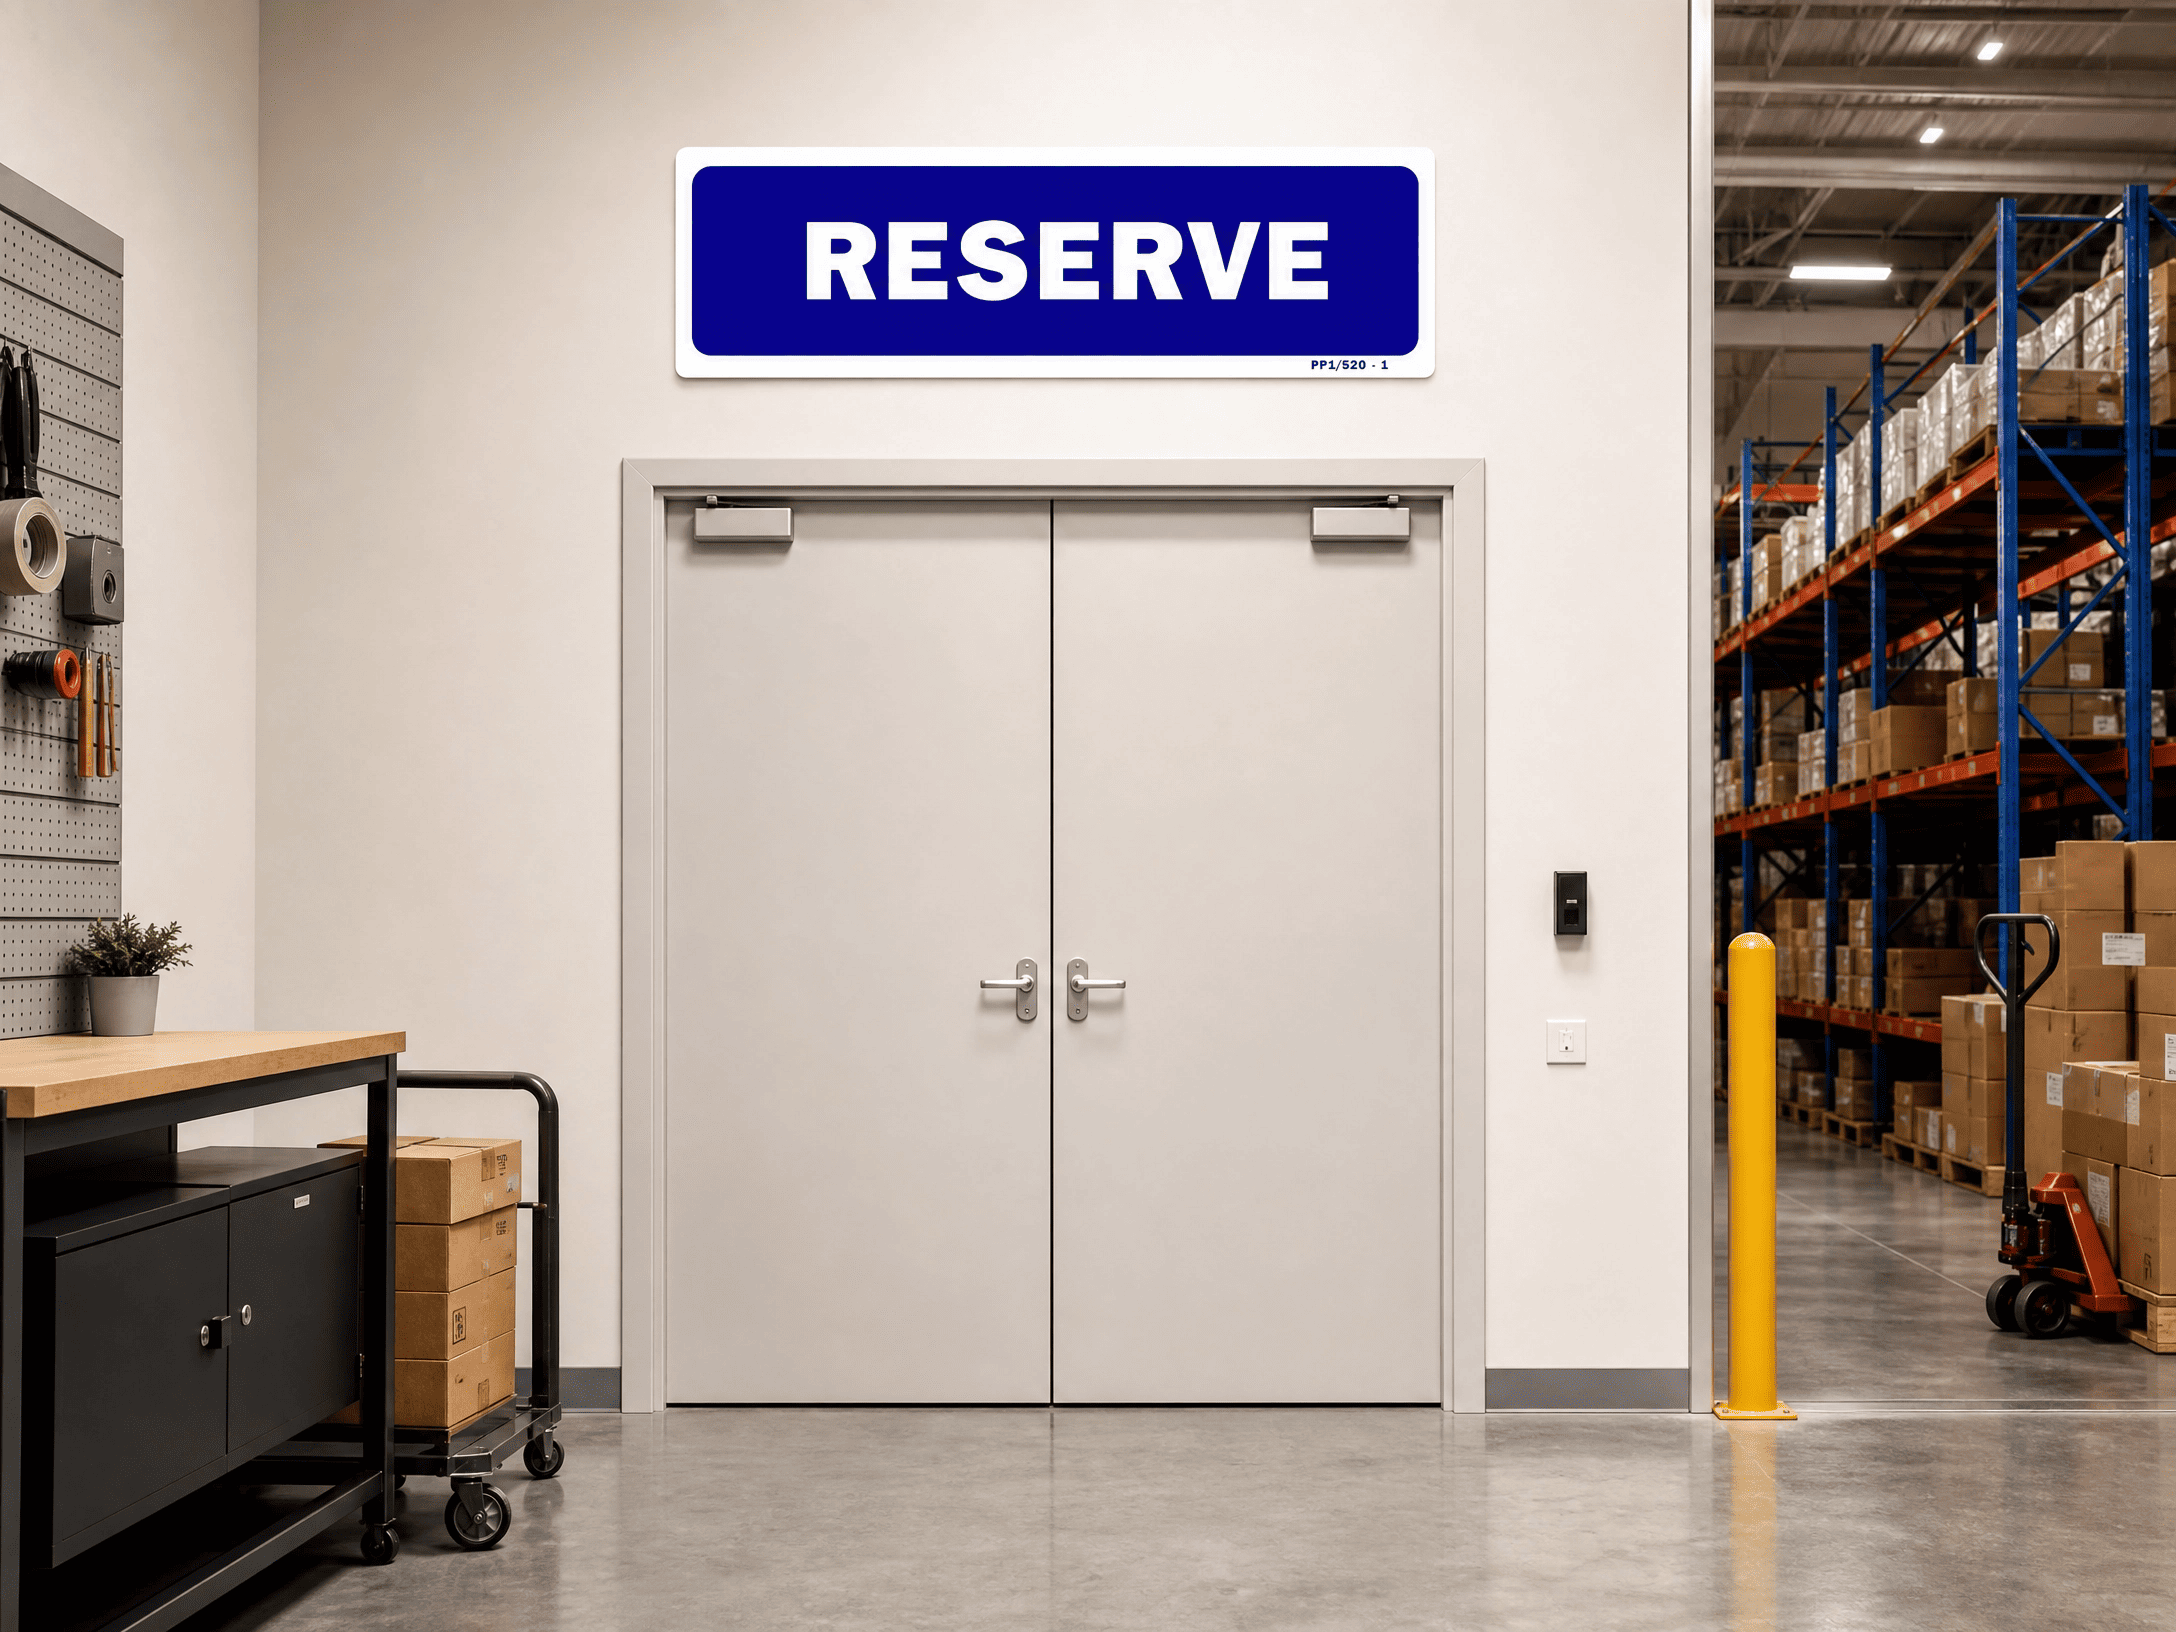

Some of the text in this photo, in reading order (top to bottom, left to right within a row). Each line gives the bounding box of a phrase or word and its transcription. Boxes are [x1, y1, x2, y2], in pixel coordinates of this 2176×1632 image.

[806, 219, 1329, 302] RESERVE
[1311, 360, 1366, 371] PP1/520
[1381, 360, 1389, 370] 1
